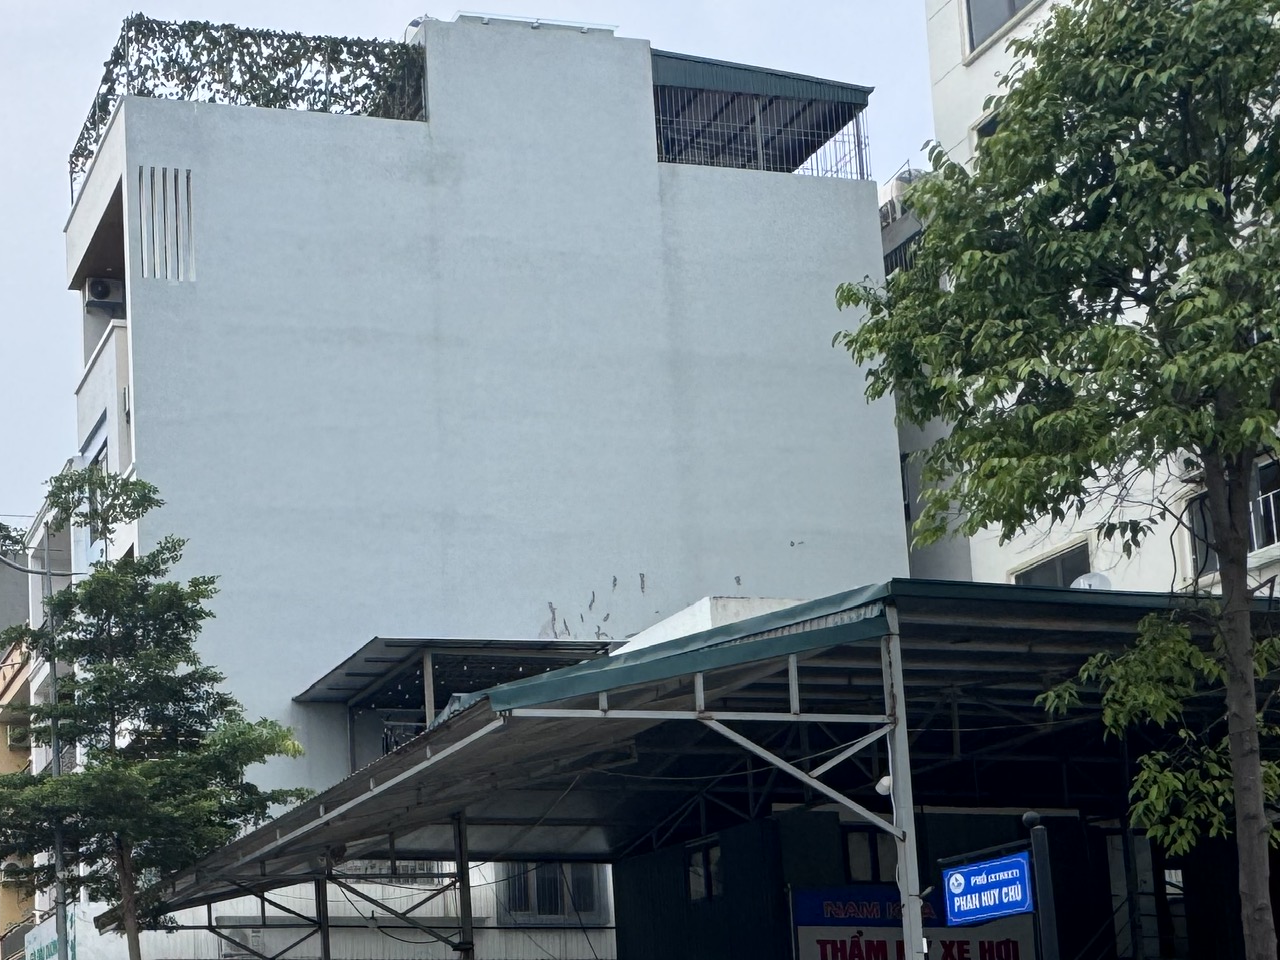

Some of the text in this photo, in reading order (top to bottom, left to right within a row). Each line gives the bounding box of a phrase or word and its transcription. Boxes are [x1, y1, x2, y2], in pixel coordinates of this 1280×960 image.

[823, 900, 880, 919] NAM
[954, 893, 980, 912] PHAN
[981, 888, 1000, 906] HUY
